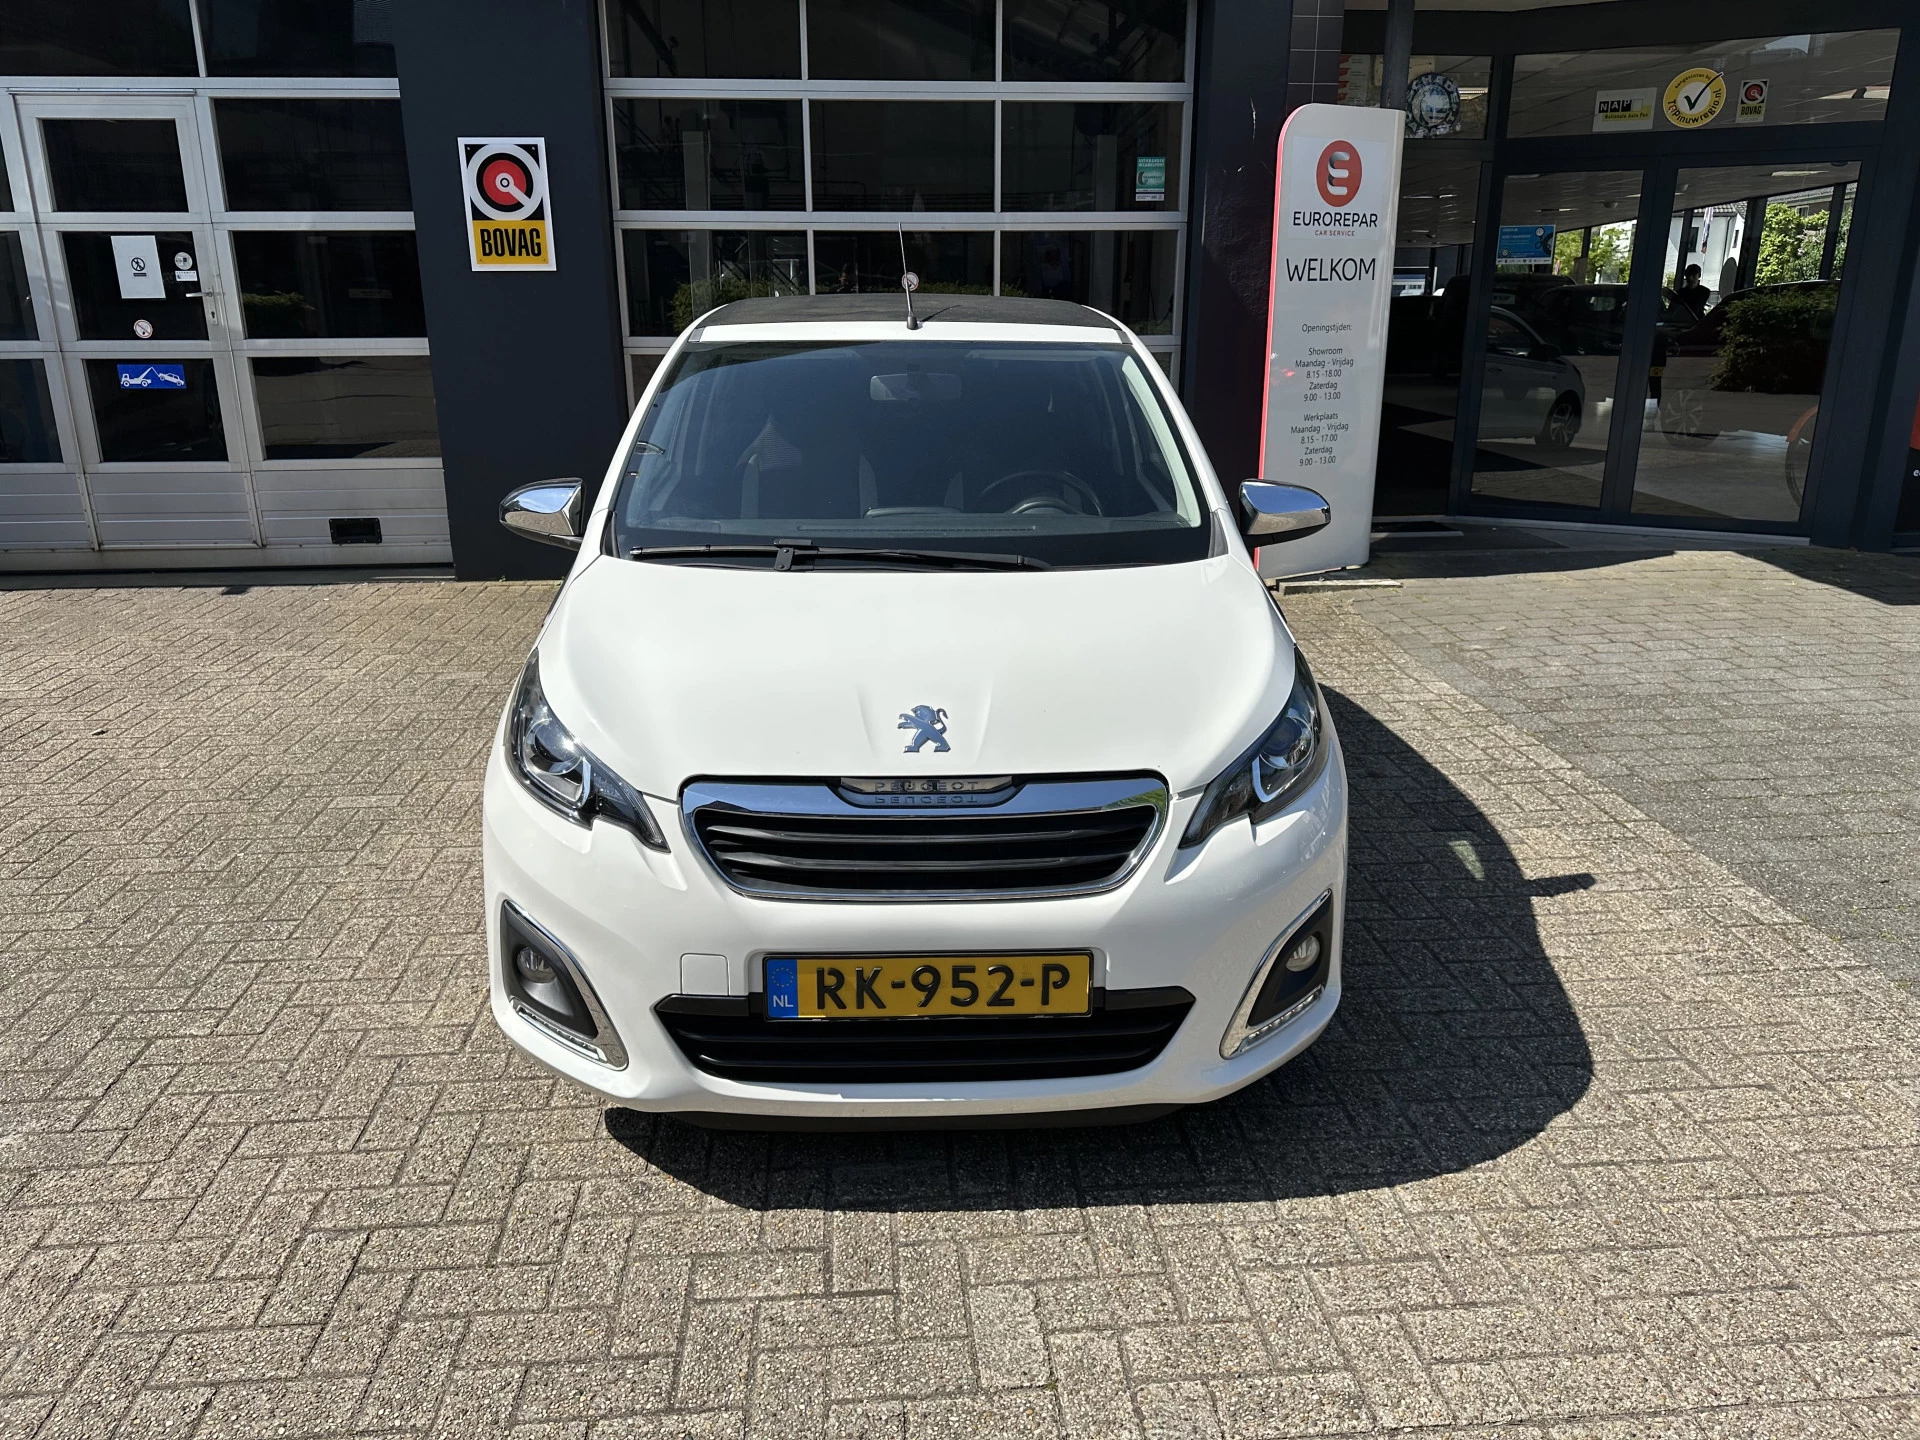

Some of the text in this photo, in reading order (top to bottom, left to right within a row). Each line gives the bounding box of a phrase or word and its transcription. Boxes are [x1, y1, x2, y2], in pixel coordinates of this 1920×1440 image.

[1600, 100, 1630, 111] NAP
[1741, 106, 1762, 116] BOVAG
[1293, 211, 1378, 228] EUROREPAR
[480, 228, 542, 257] BOVAG
[1286, 258, 1376, 282] WELKOM
[1302, 322, 1352, 334] Openingstijden:
[1295, 359, 1325, 368] Maandag
[1332, 357, 1354, 367] Vrijdag
[1306, 370, 1320, 378] 8.15
[1309, 381, 1338, 390] Zaterdag
[1304, 393, 1317, 402] 9.00
[1324, 392, 1341, 400] 13.00
[1304, 412, 1338, 422] Werkplaats
[1291, 425, 1320, 434] Maandag
[1327, 422, 1349, 432] Vrijdag
[1301, 436, 1314, 444] 8.15
[1321, 434, 1338, 442] 17.00
[1305, 445, 1332, 455] Zaterdag
[1300, 458, 1313, 466] 9.00
[1320, 456, 1336, 464] 13.00
[874, 782, 978, 792] PEUGEOT
[816, 964, 1070, 1009] RK-952-P
[772, 995, 794, 1008] NL
